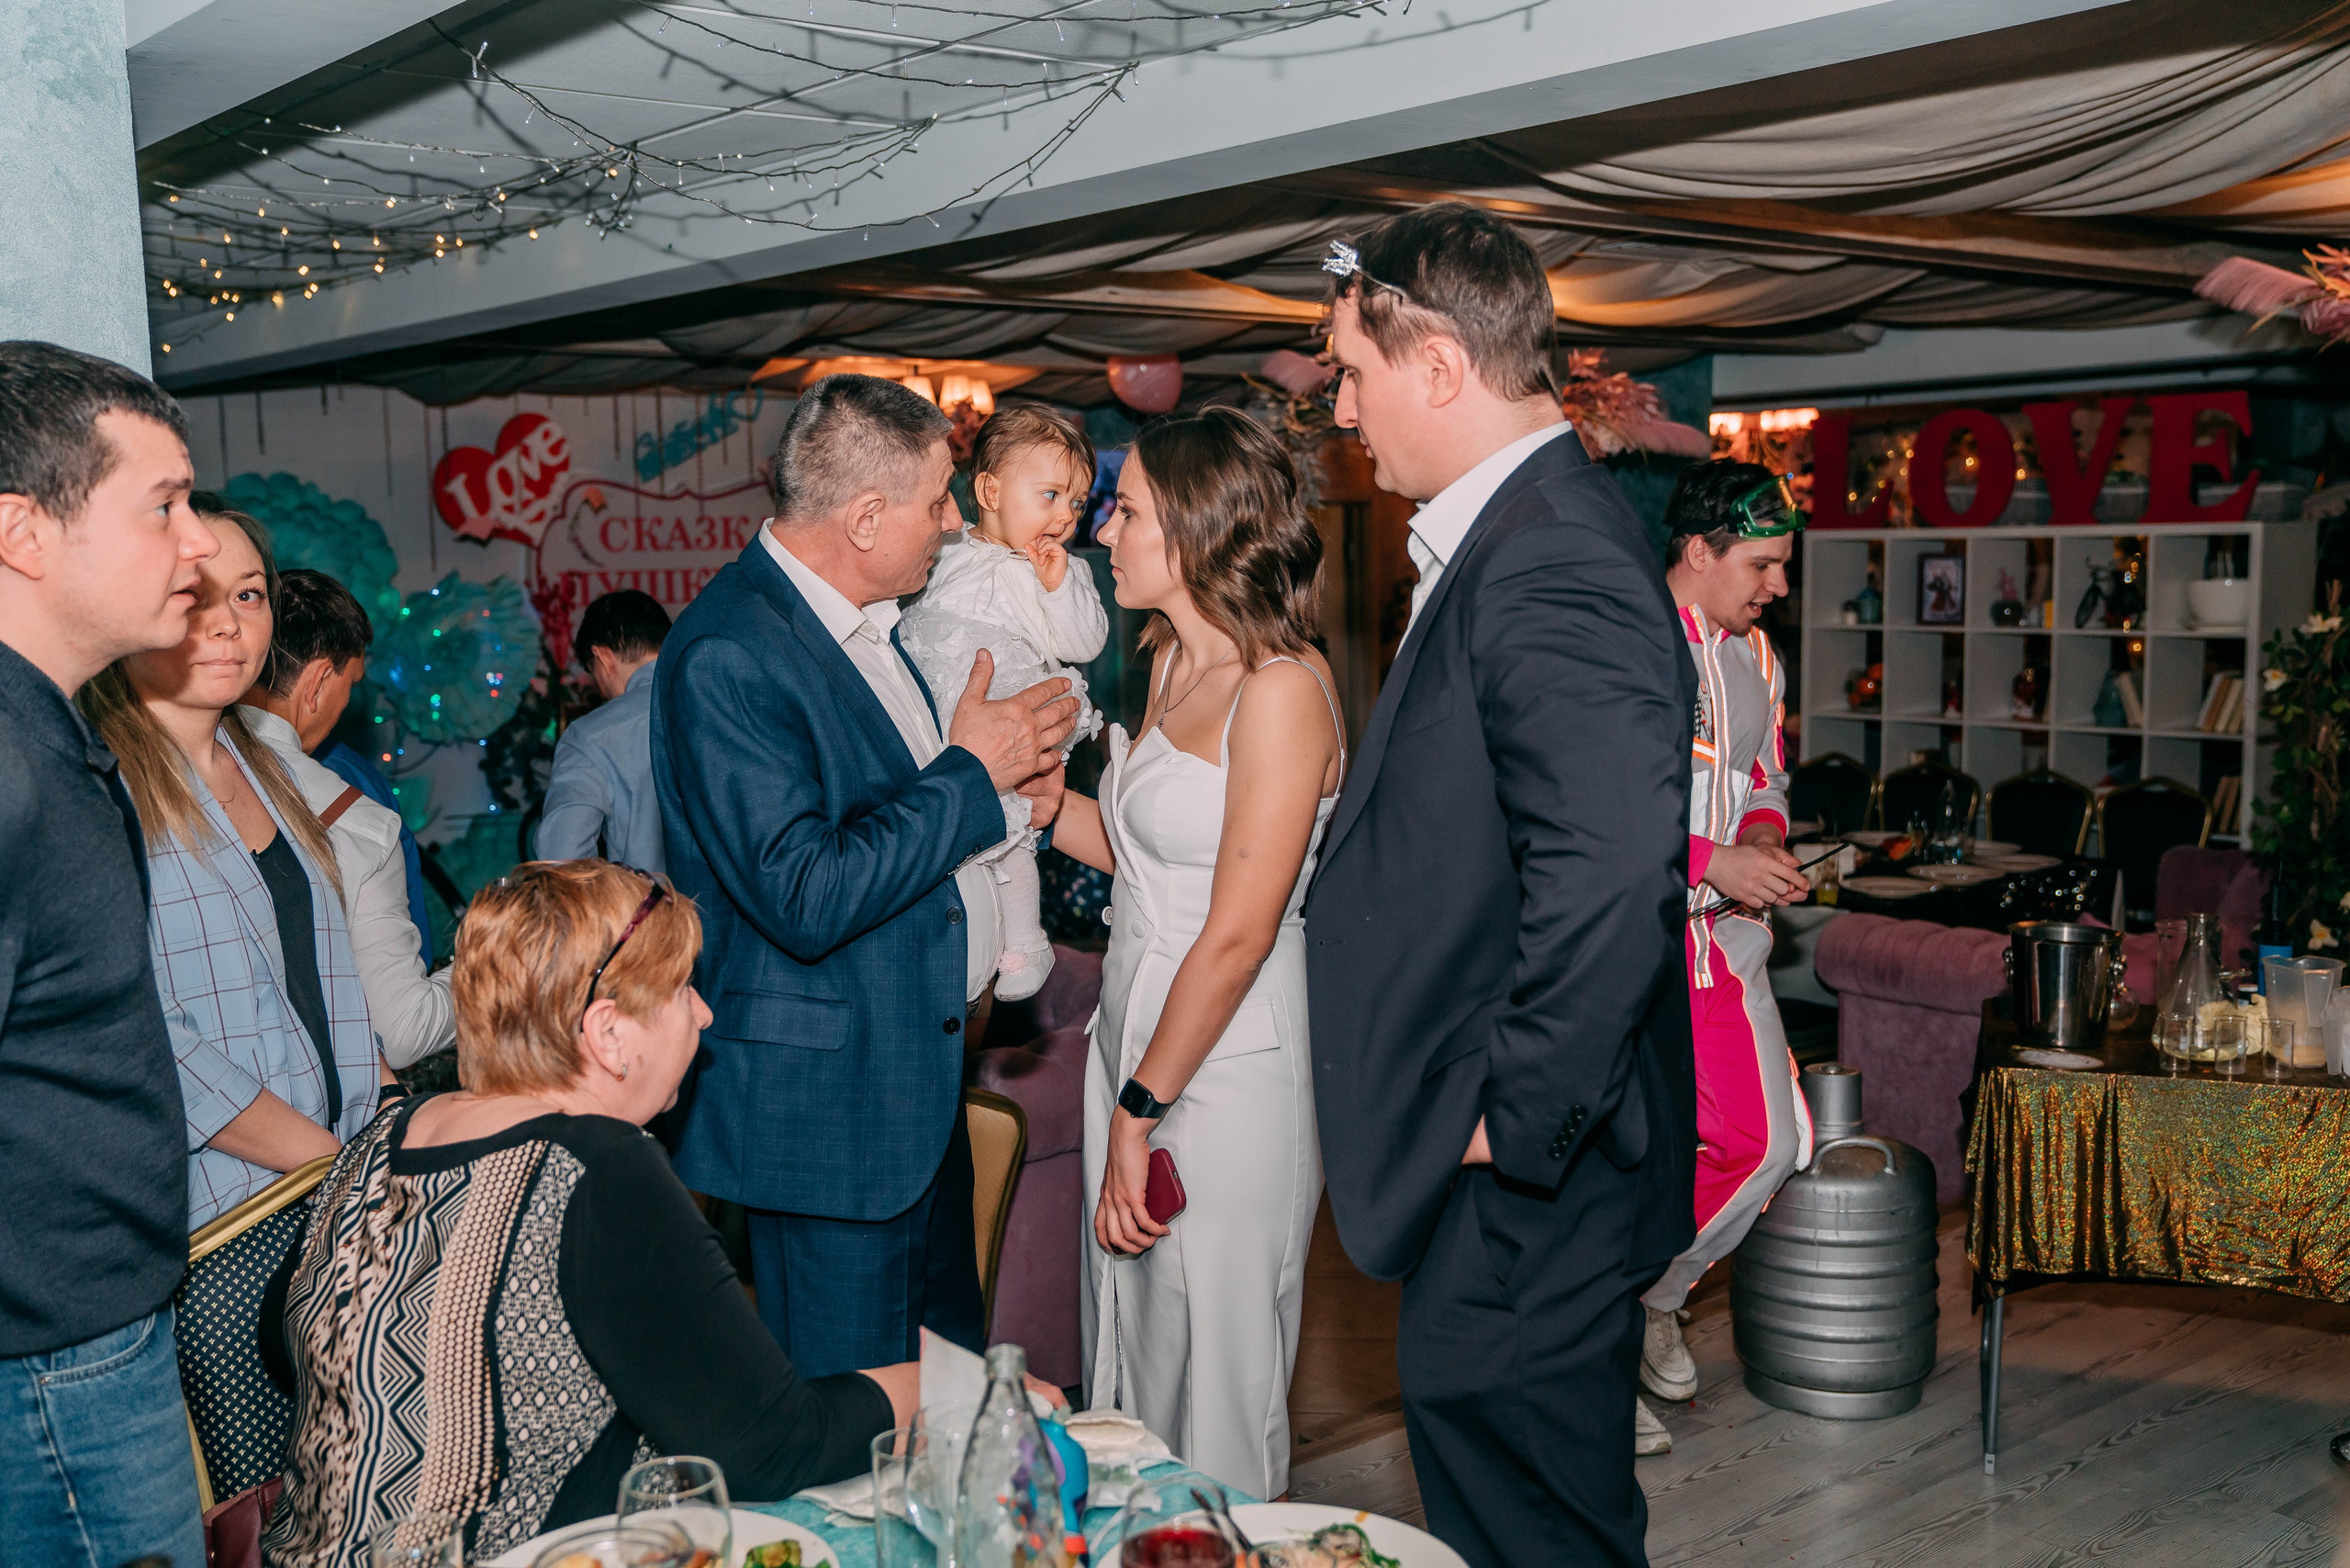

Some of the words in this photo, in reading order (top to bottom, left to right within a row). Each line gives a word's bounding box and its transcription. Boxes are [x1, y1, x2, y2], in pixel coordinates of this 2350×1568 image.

[1807, 391, 2260, 528] LOVE
[599, 516, 767, 553] СКАЗК
[557, 567, 722, 609] ПУШК
